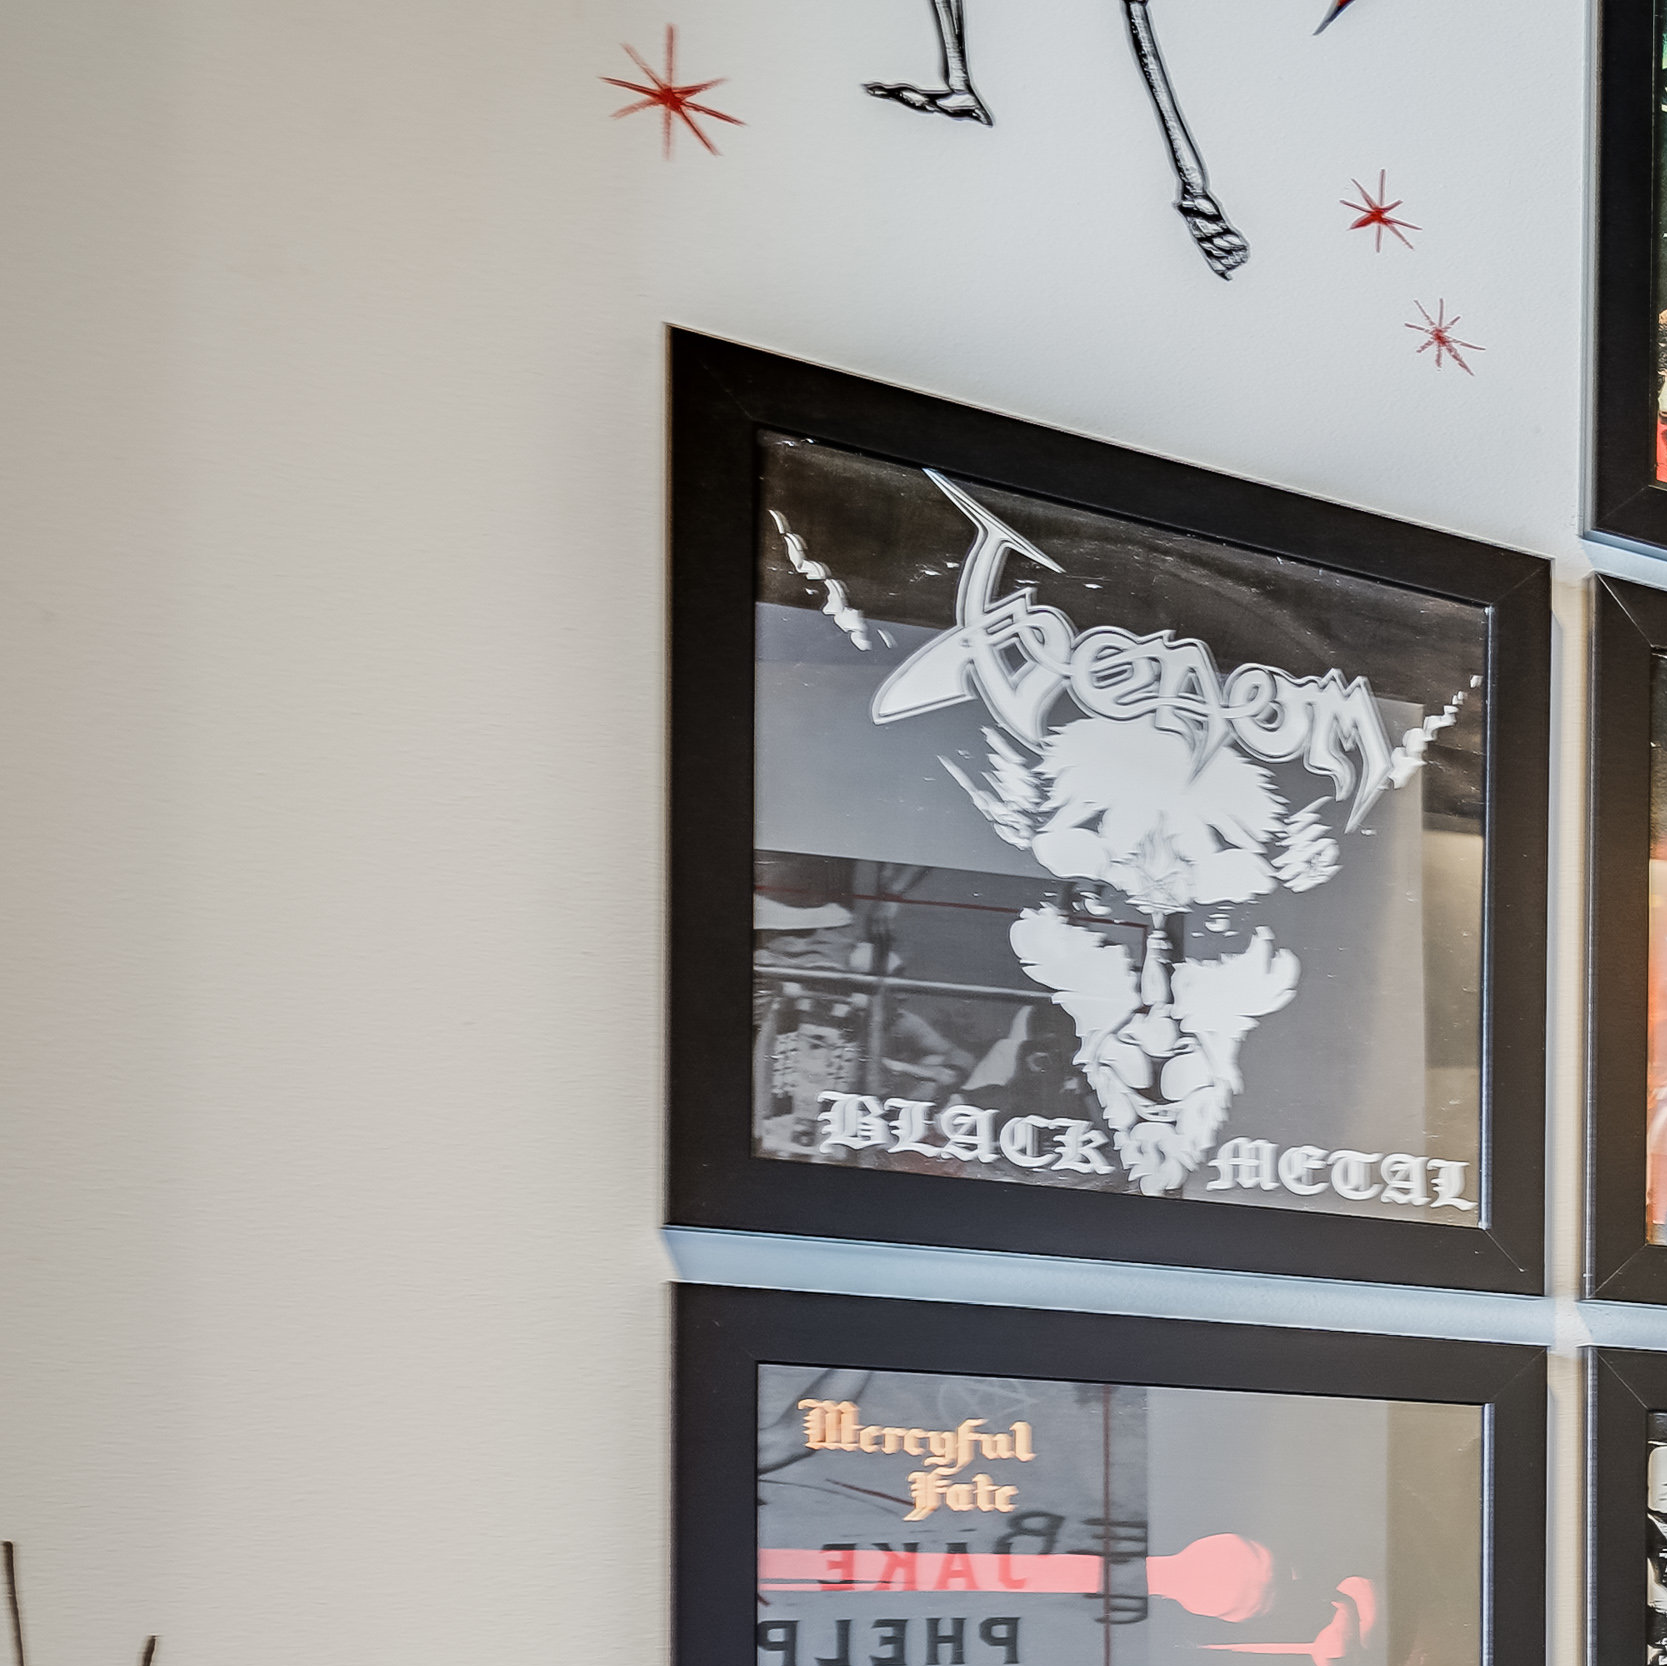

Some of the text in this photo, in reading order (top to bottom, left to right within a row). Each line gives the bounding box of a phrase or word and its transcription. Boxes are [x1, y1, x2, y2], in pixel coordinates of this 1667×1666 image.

[818, 1089, 1115, 1176] BLACK
[798, 1399, 1037, 1475] Mercyful
[903, 1464, 1020, 1522] Fate
